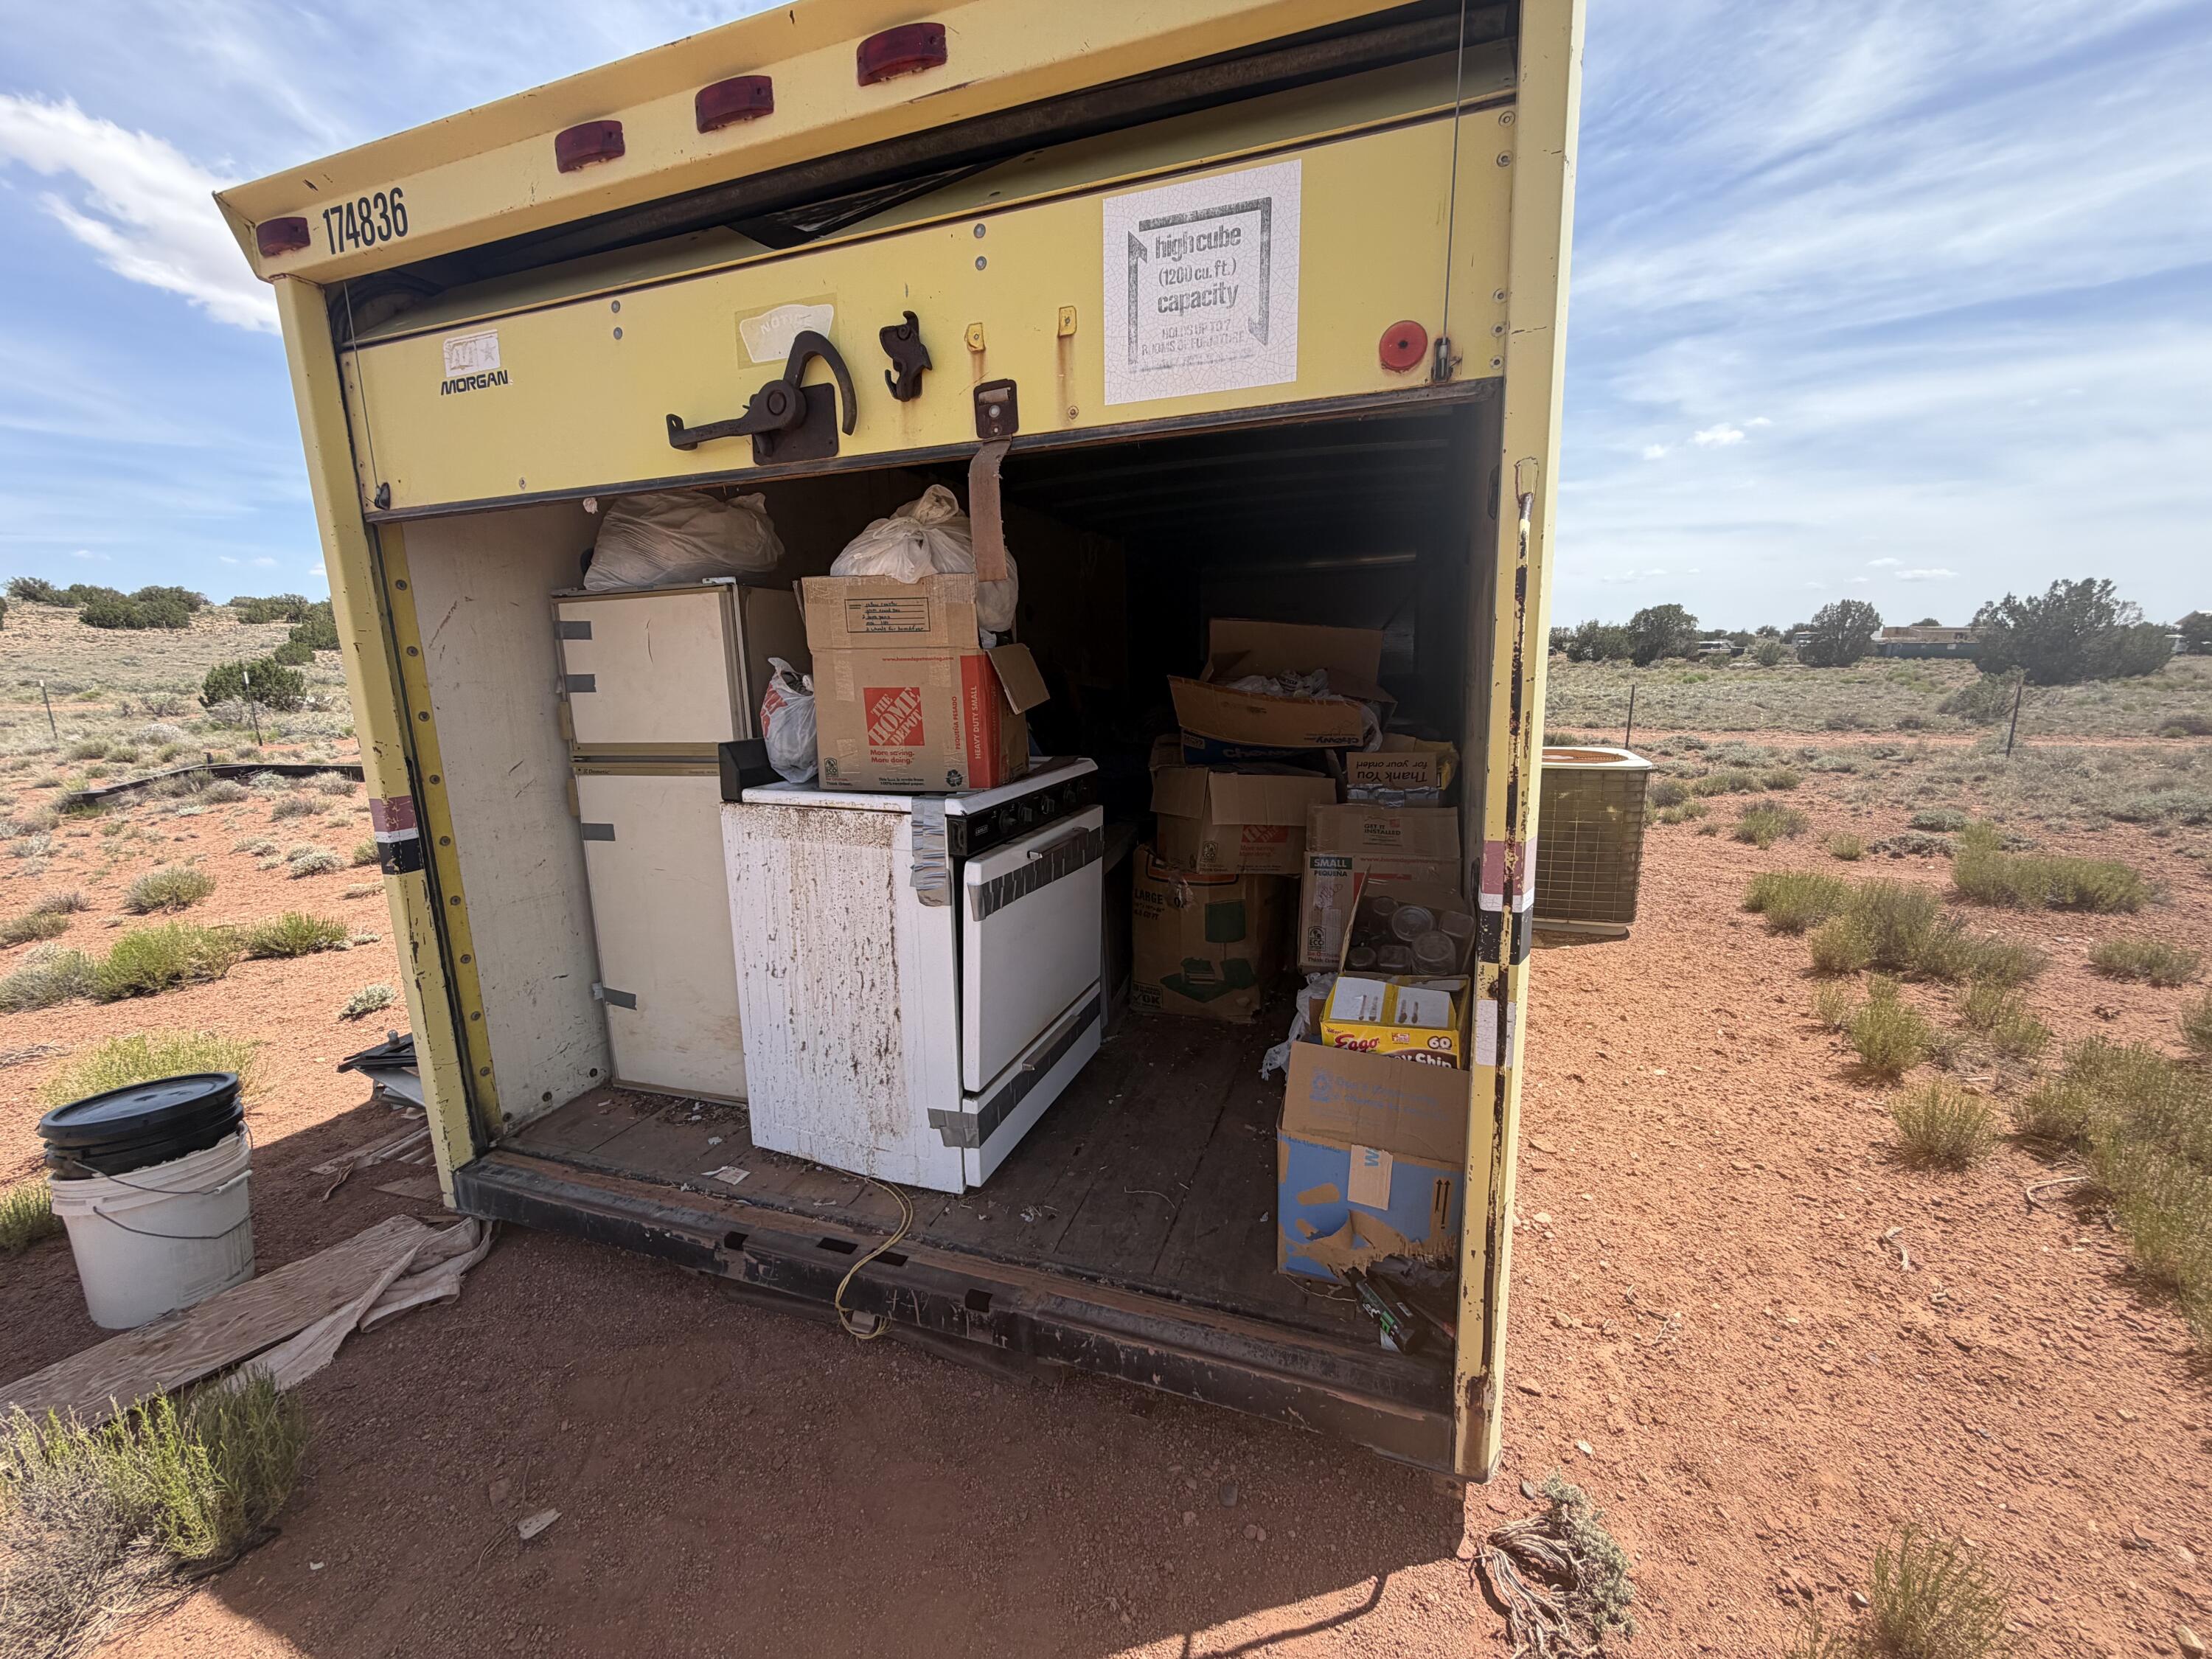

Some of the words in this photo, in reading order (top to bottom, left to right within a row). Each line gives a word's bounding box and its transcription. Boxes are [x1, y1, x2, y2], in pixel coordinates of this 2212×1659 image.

[322, 187, 408, 255] 174836
[1196, 225, 1242, 252] cube
[1158, 265, 1193, 289] (1200
[1194, 267, 1213, 281] cu.
[1158, 281, 1239, 316] capacity
[440, 369, 509, 396] MORGAN
[871, 692, 894, 718] THE
[970, 685, 978, 712] SMALL
[868, 687, 921, 746] HOME
[972, 713, 980, 731] DUTY
[890, 709, 922, 745] DEPOT
[973, 734, 981, 759] HEAVY
[1356, 760, 1385, 770] order!
[1385, 759, 1409, 768] your
[1413, 761, 1428, 770] for
[1357, 771, 1382, 782] You
[1385, 771, 1427, 783] Thank
[1363, 828, 1402, 836] INSTALLED
[1314, 858, 1348, 868] SMALL
[1134, 888, 1164, 905] LARGE
[1309, 939, 1324, 947] ECO
[1334, 1034, 1379, 1053] Eggo
[1427, 1036, 1453, 1050] 60
